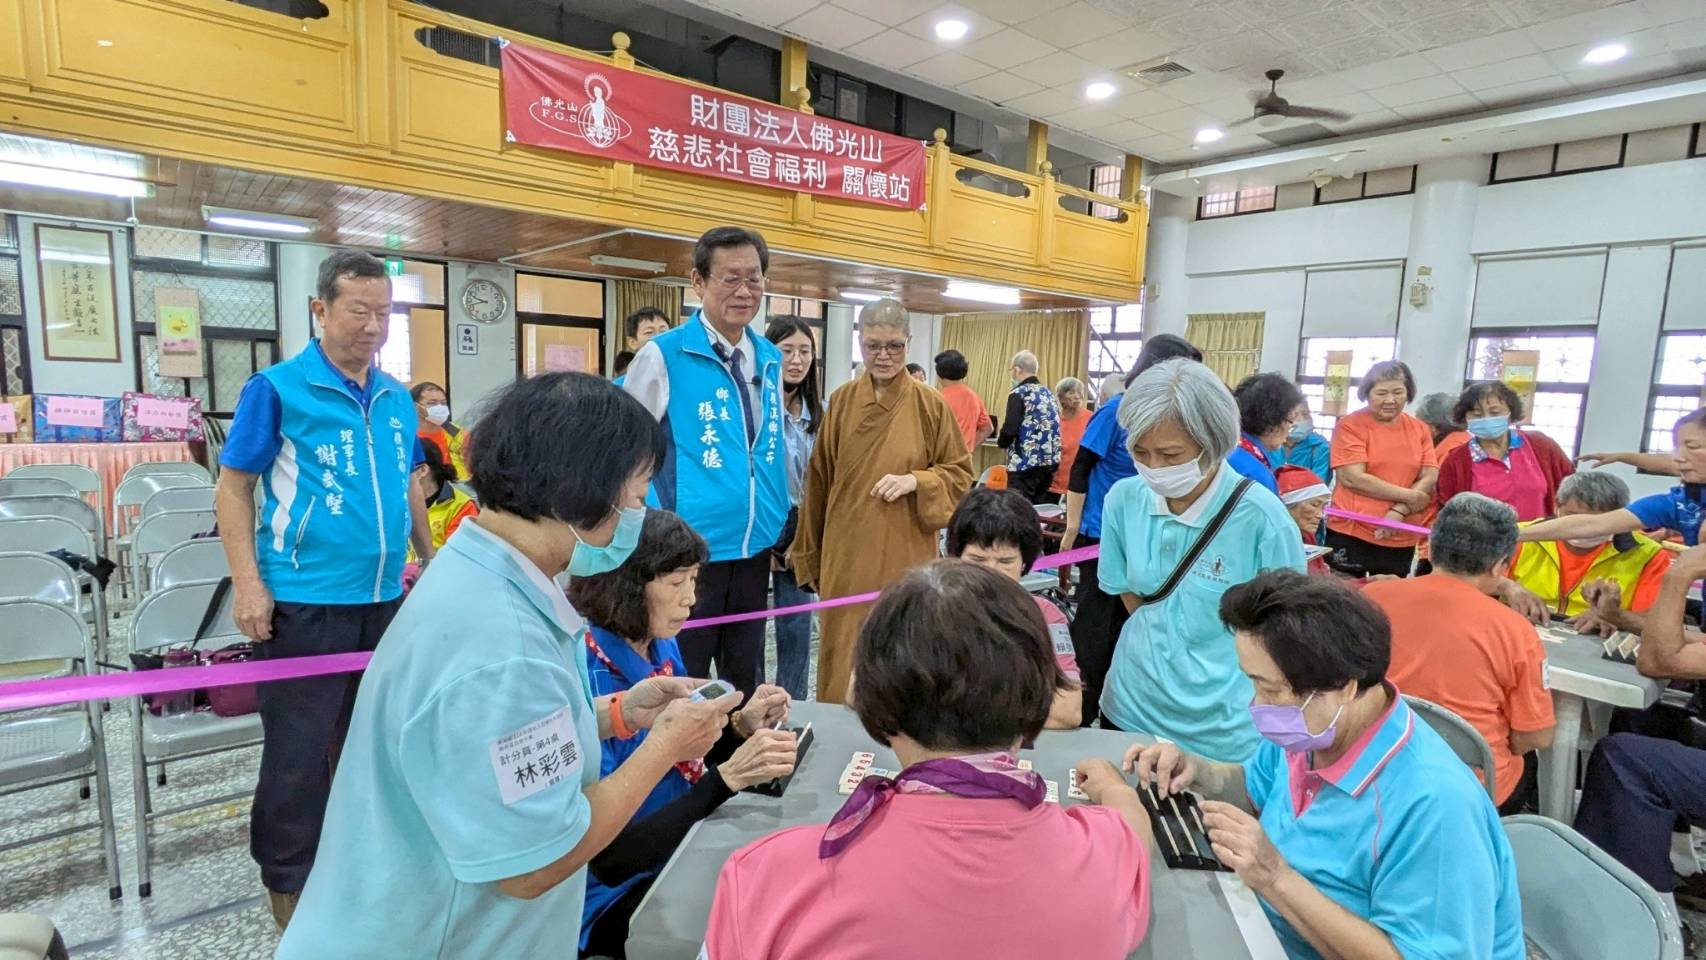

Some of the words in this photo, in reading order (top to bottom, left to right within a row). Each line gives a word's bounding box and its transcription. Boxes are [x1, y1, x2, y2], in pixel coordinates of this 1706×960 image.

[541, 95, 578, 112] 佛光山
[690, 94, 883, 163] 財團法人佛光山
[648, 126, 828, 190] 慈悲社會福利
[842, 165, 911, 202] 關懷站
[339, 429, 360, 477] 理事長
[697, 401, 723, 468] 張永德
[514, 739, 577, 788] 林彩雲
